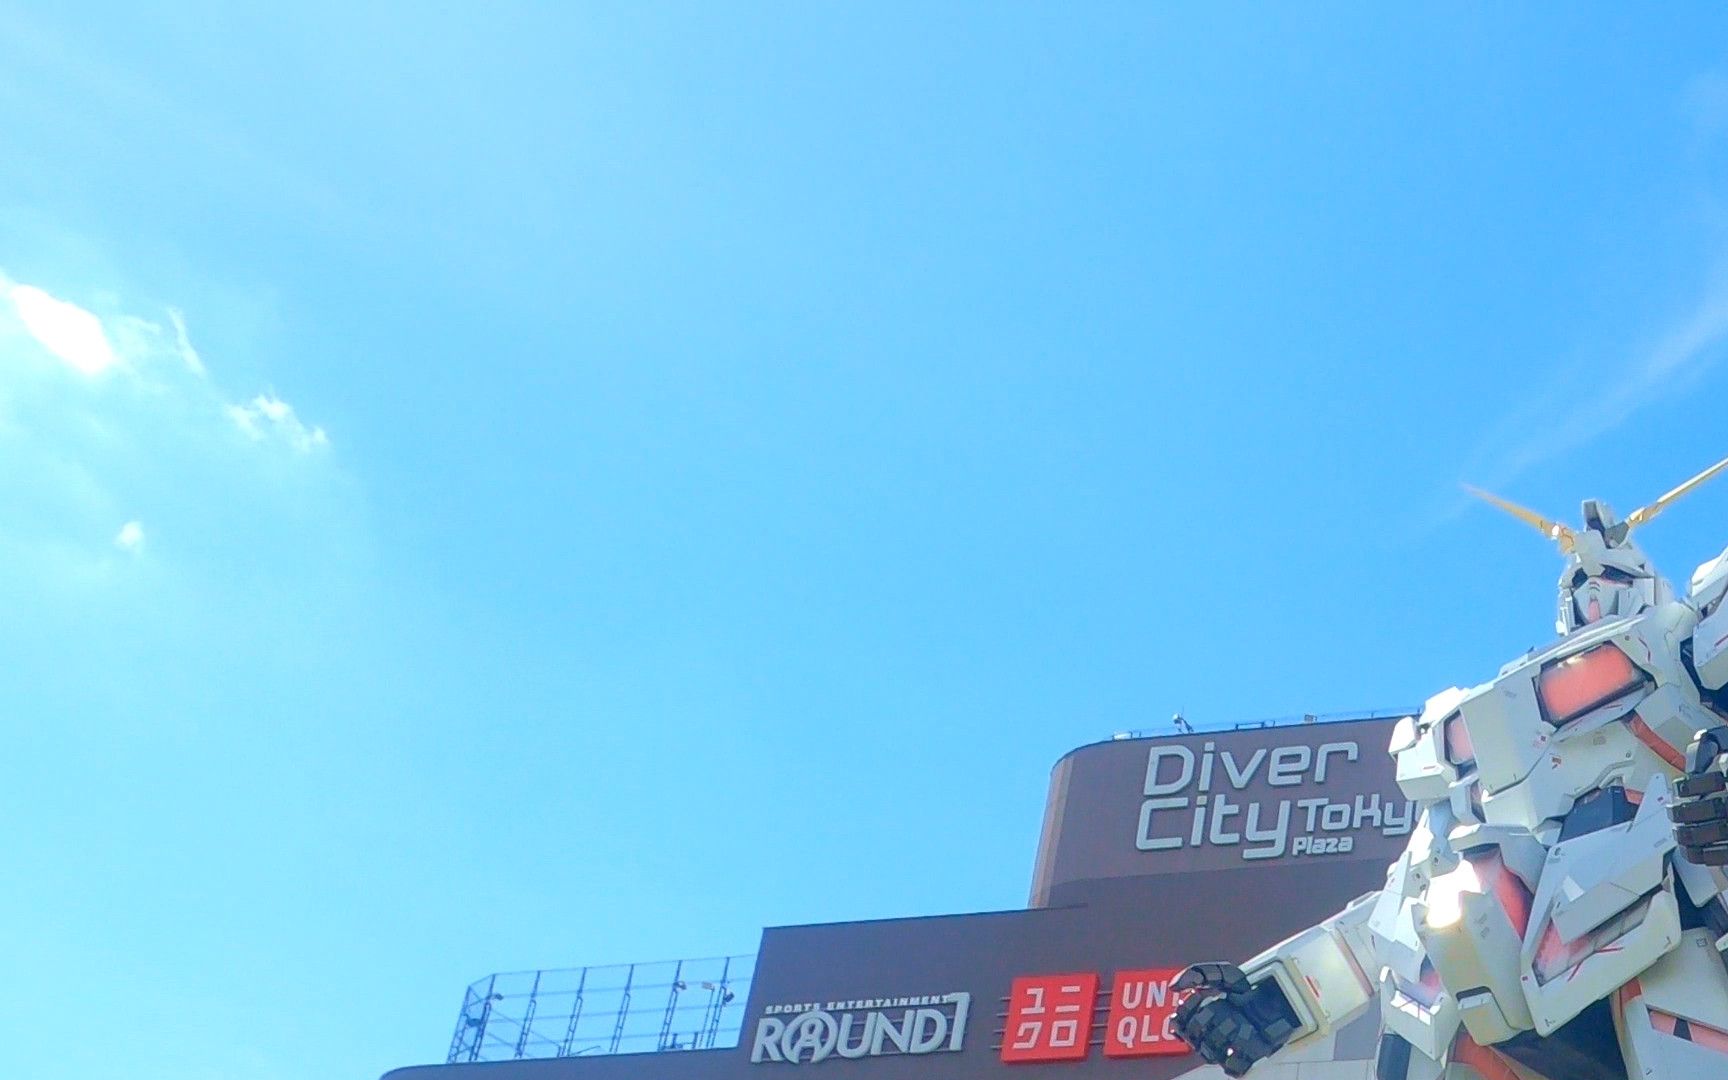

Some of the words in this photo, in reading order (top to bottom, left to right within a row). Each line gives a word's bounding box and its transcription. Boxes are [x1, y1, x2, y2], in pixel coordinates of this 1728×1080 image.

[1143, 741, 1358, 797] Diver
[1135, 794, 1291, 861] City
[1292, 835, 1354, 856] Plaza
[751, 992, 970, 1064] ROUND1
[765, 1003, 821, 1015] SPORTS
[827, 995, 950, 1011] ENTERTAINMENT
